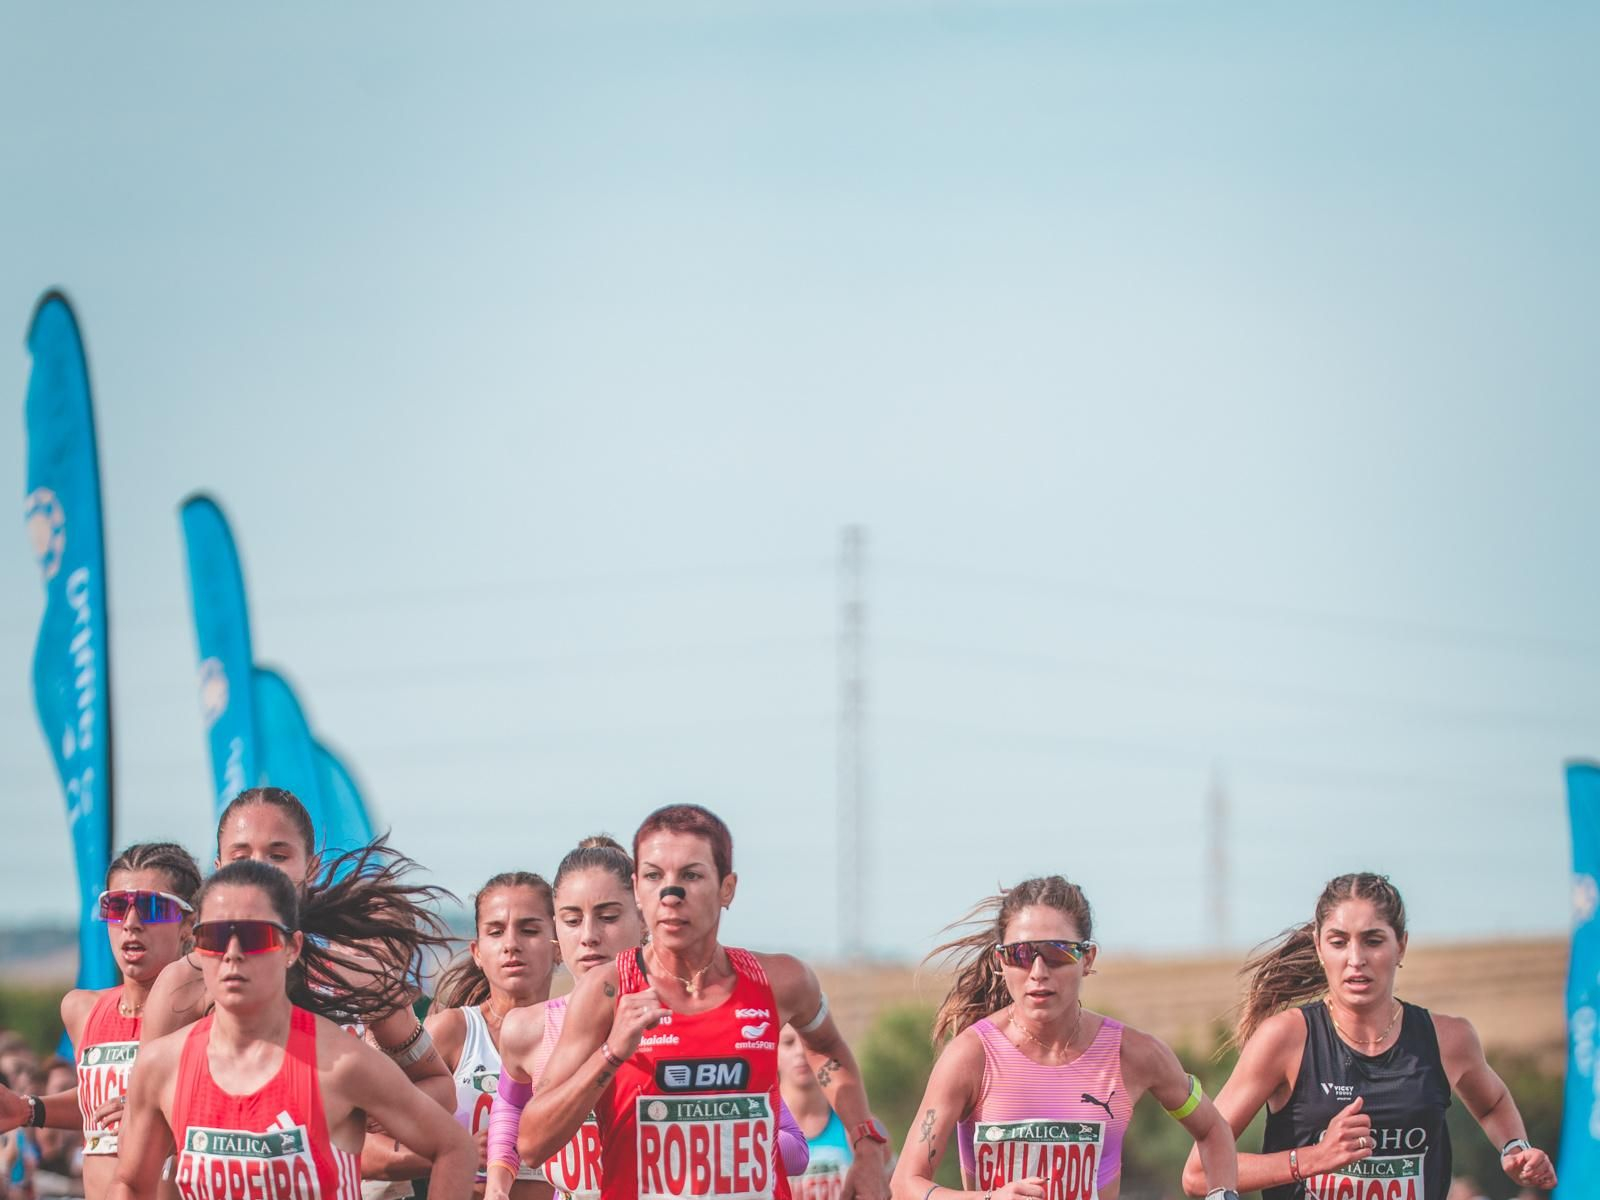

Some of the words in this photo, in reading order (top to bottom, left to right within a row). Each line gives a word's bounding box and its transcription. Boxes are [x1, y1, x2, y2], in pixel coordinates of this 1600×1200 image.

[695, 1062, 742, 1087] BM
[677, 1100, 741, 1117] ITÁLICA
[1011, 1123, 1070, 1138] ITÁLICA
[212, 1133, 273, 1153] ITÁLICA
[640, 1119, 768, 1196] ROBLES
